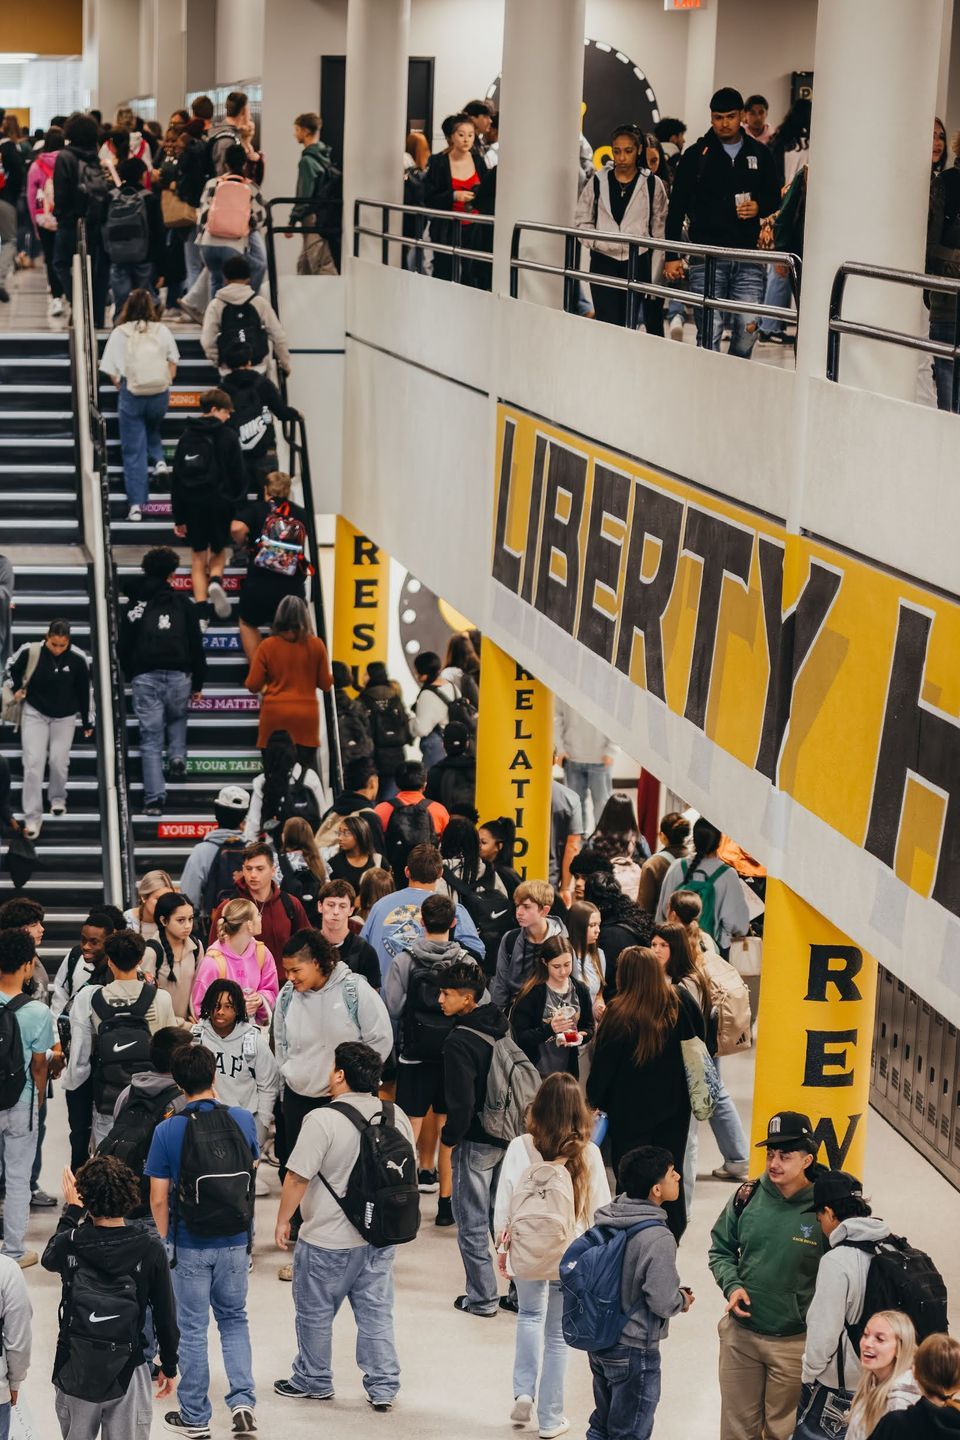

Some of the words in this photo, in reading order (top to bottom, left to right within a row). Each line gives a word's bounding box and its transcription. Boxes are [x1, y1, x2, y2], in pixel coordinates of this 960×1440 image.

[492, 416, 844, 792] LIBERTY
[195, 760, 227, 770] YOUR
[161, 825, 196, 835] YOUR
